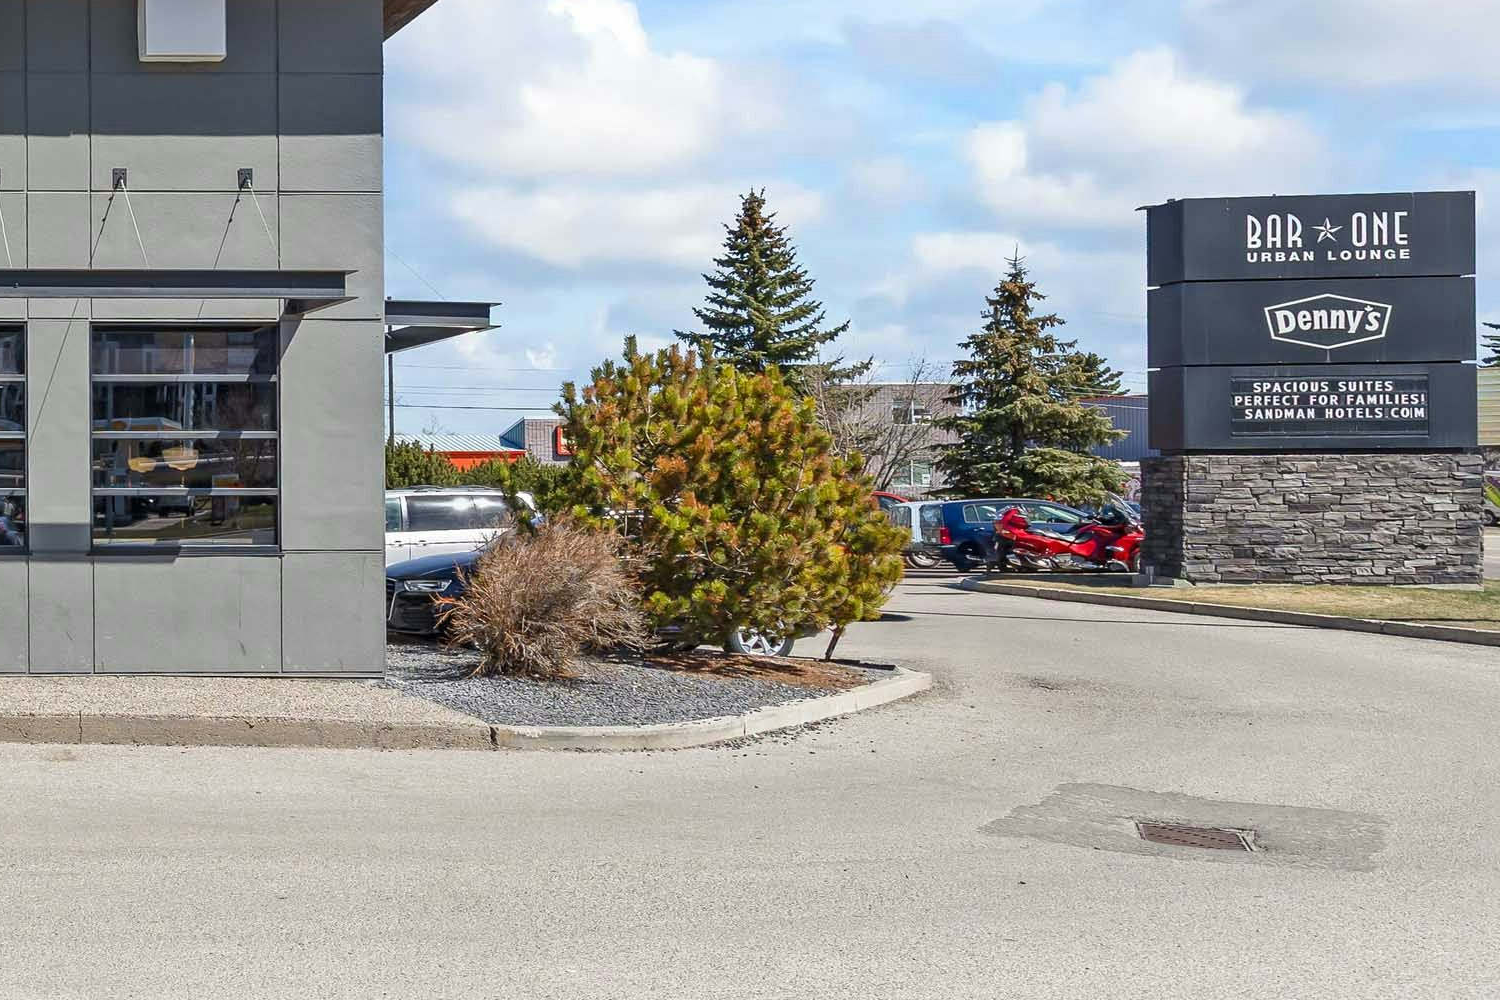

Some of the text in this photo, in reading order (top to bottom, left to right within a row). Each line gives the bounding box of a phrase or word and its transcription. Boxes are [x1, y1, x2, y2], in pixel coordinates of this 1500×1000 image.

[1246, 211, 1408, 249] BAR ONE
[1247, 249, 1411, 263] URBAN LOUNGE
[1274, 305, 1381, 334] Denny's
[1253, 380, 1394, 393] SPACIOUS SUITES
[1234, 393, 1425, 407] PERFECT FOR FAMILIES!
[1244, 408, 1316, 419] SANDMAN
